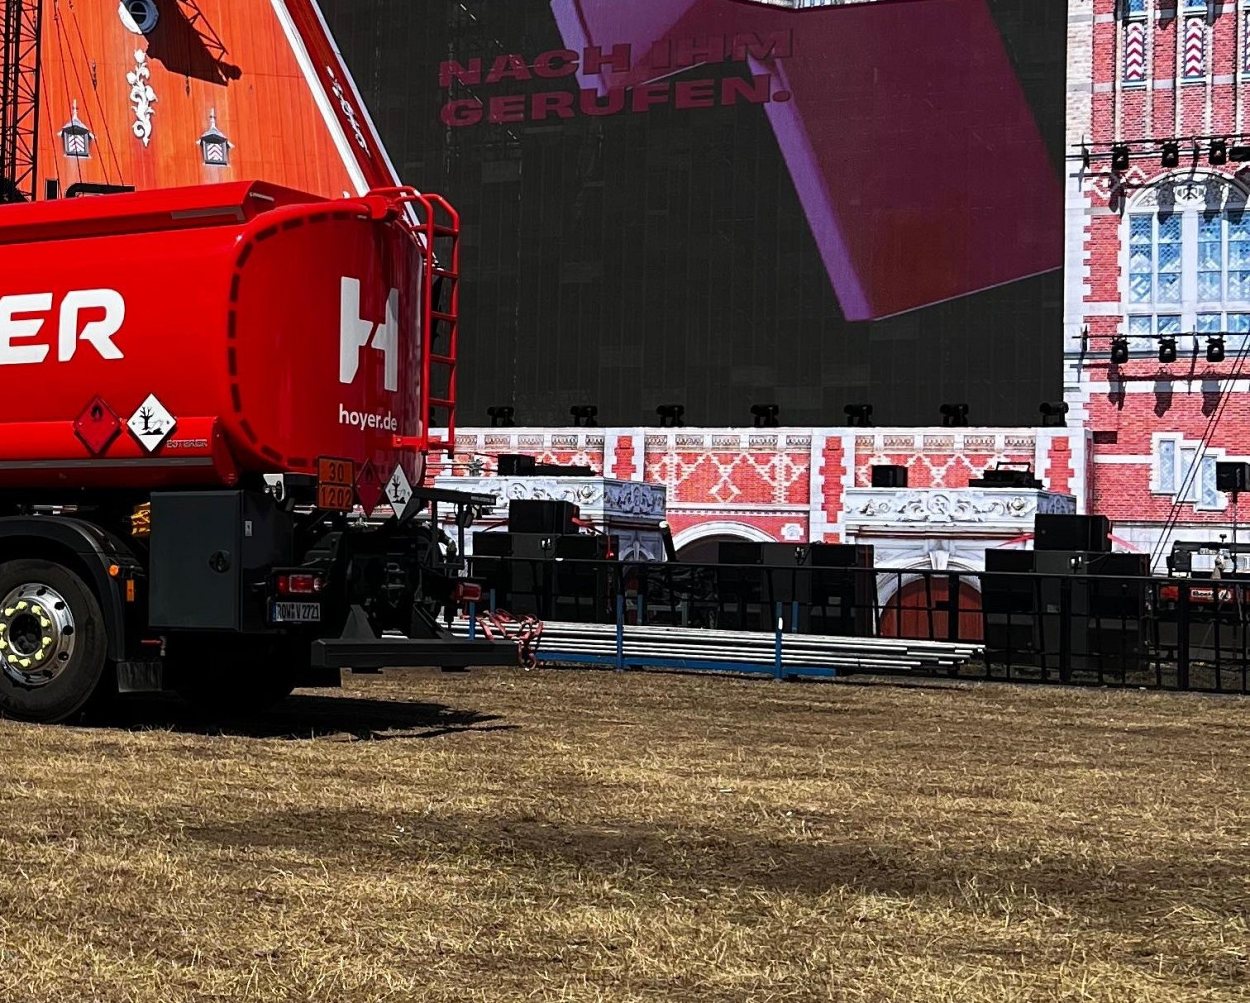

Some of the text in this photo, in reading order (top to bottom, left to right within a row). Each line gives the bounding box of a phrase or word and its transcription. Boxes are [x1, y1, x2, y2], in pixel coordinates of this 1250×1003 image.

[438, 28, 794, 88] NACH IHM
[439, 73, 793, 128] GERUFEN.
[338, 403, 398, 432] hoyer.de
[328, 461, 345, 482] 30
[320, 486, 352, 507] 1202
